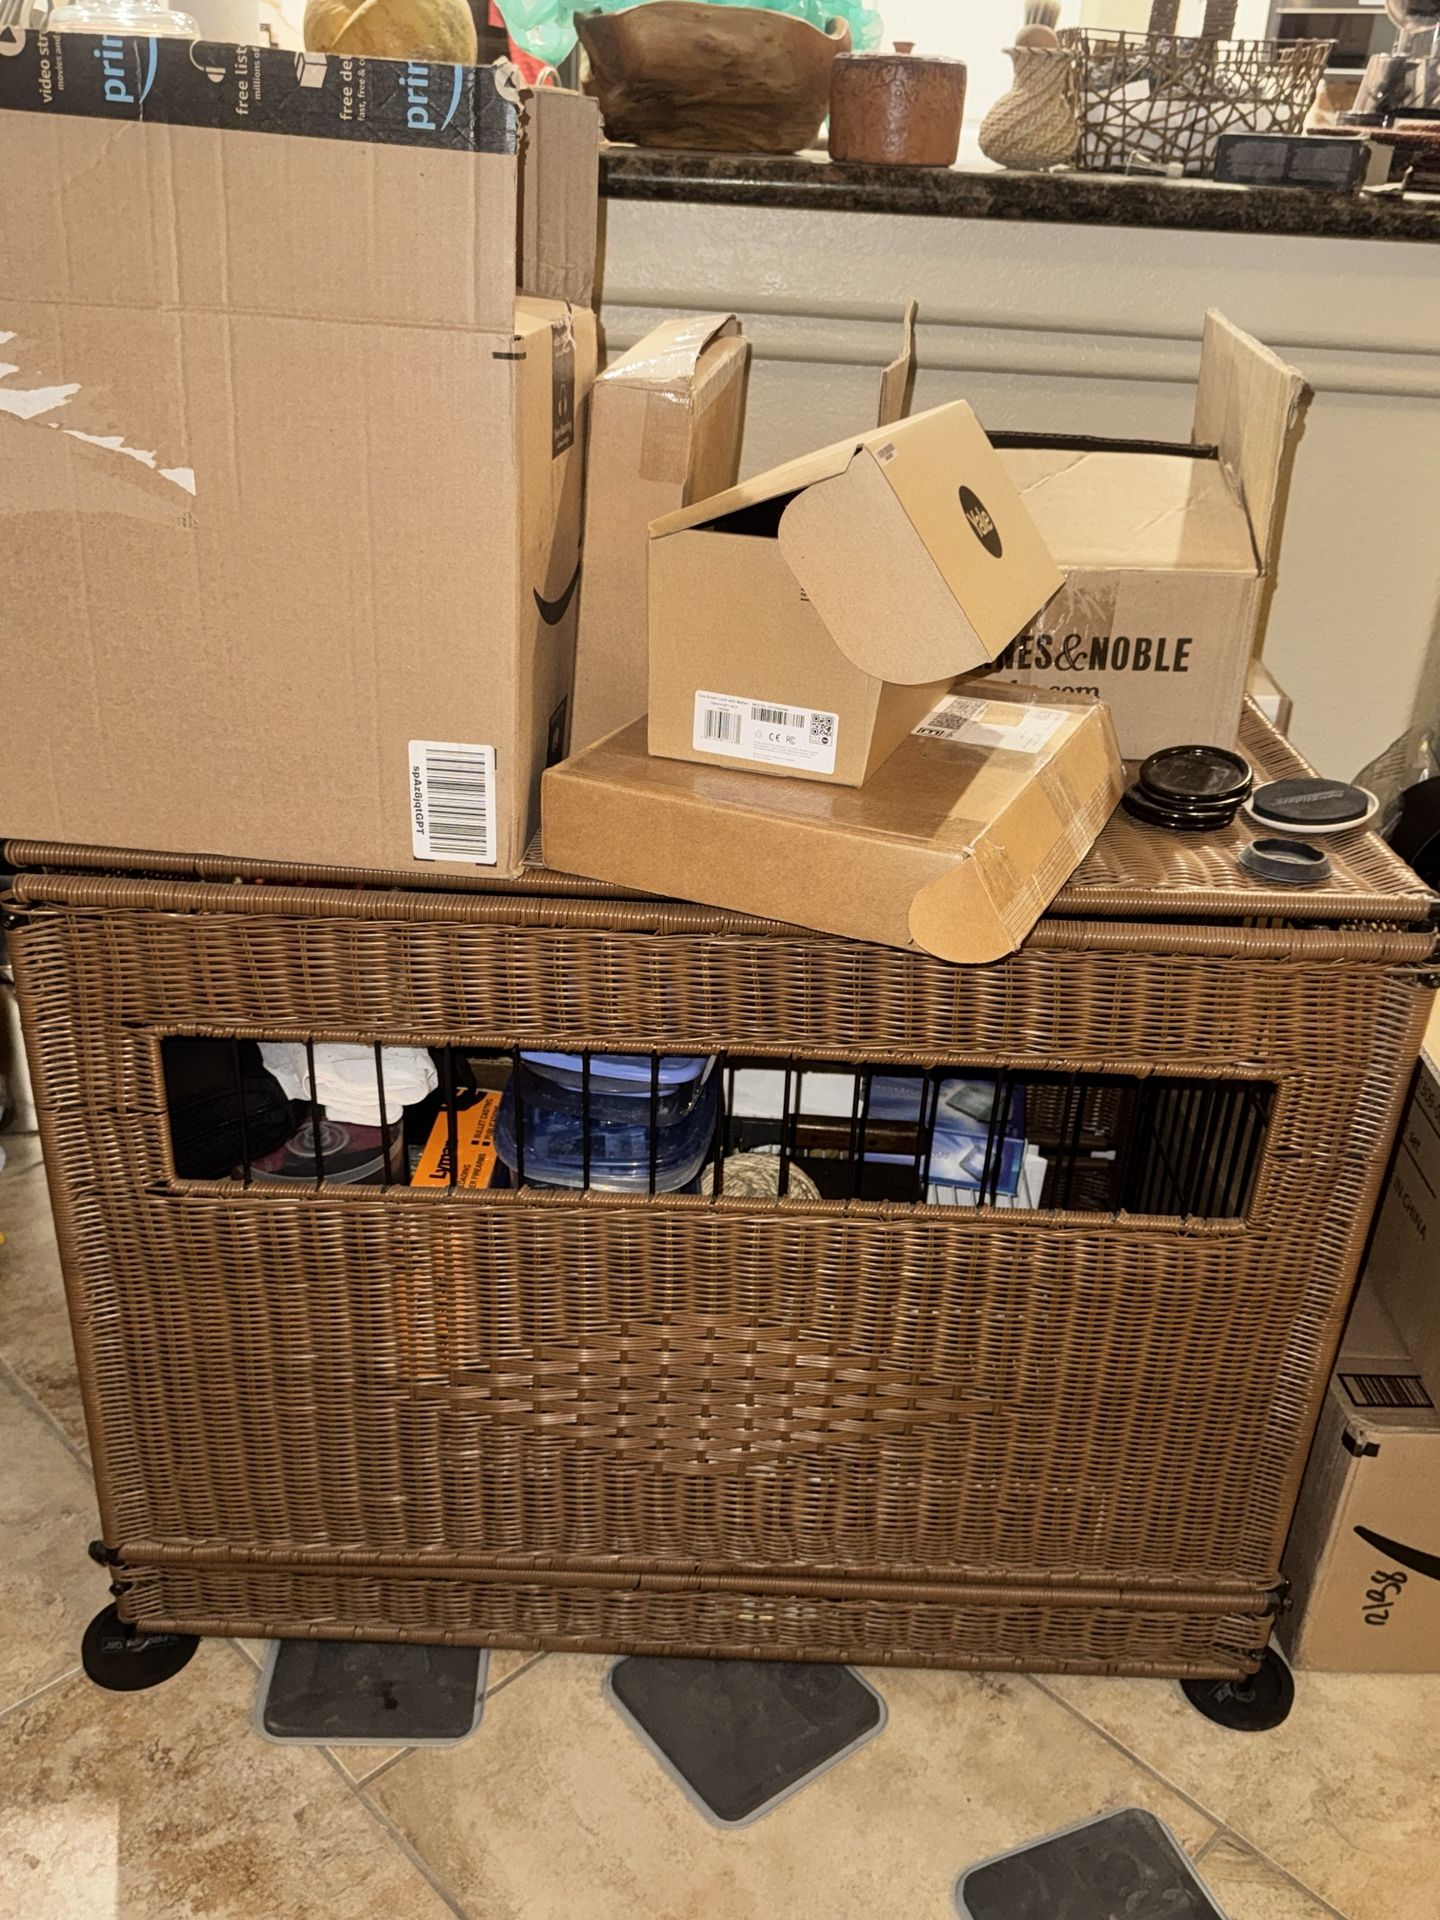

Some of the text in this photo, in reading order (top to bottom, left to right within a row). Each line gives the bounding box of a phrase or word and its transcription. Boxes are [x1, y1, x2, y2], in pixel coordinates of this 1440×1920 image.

[38, 59, 53, 104] video
[53, 34, 64, 91] movies and
[234, 44, 249, 117] free list
[252, 60, 262, 100] millions
[339, 86, 354, 121] free
[356, 78, 366, 99] free
